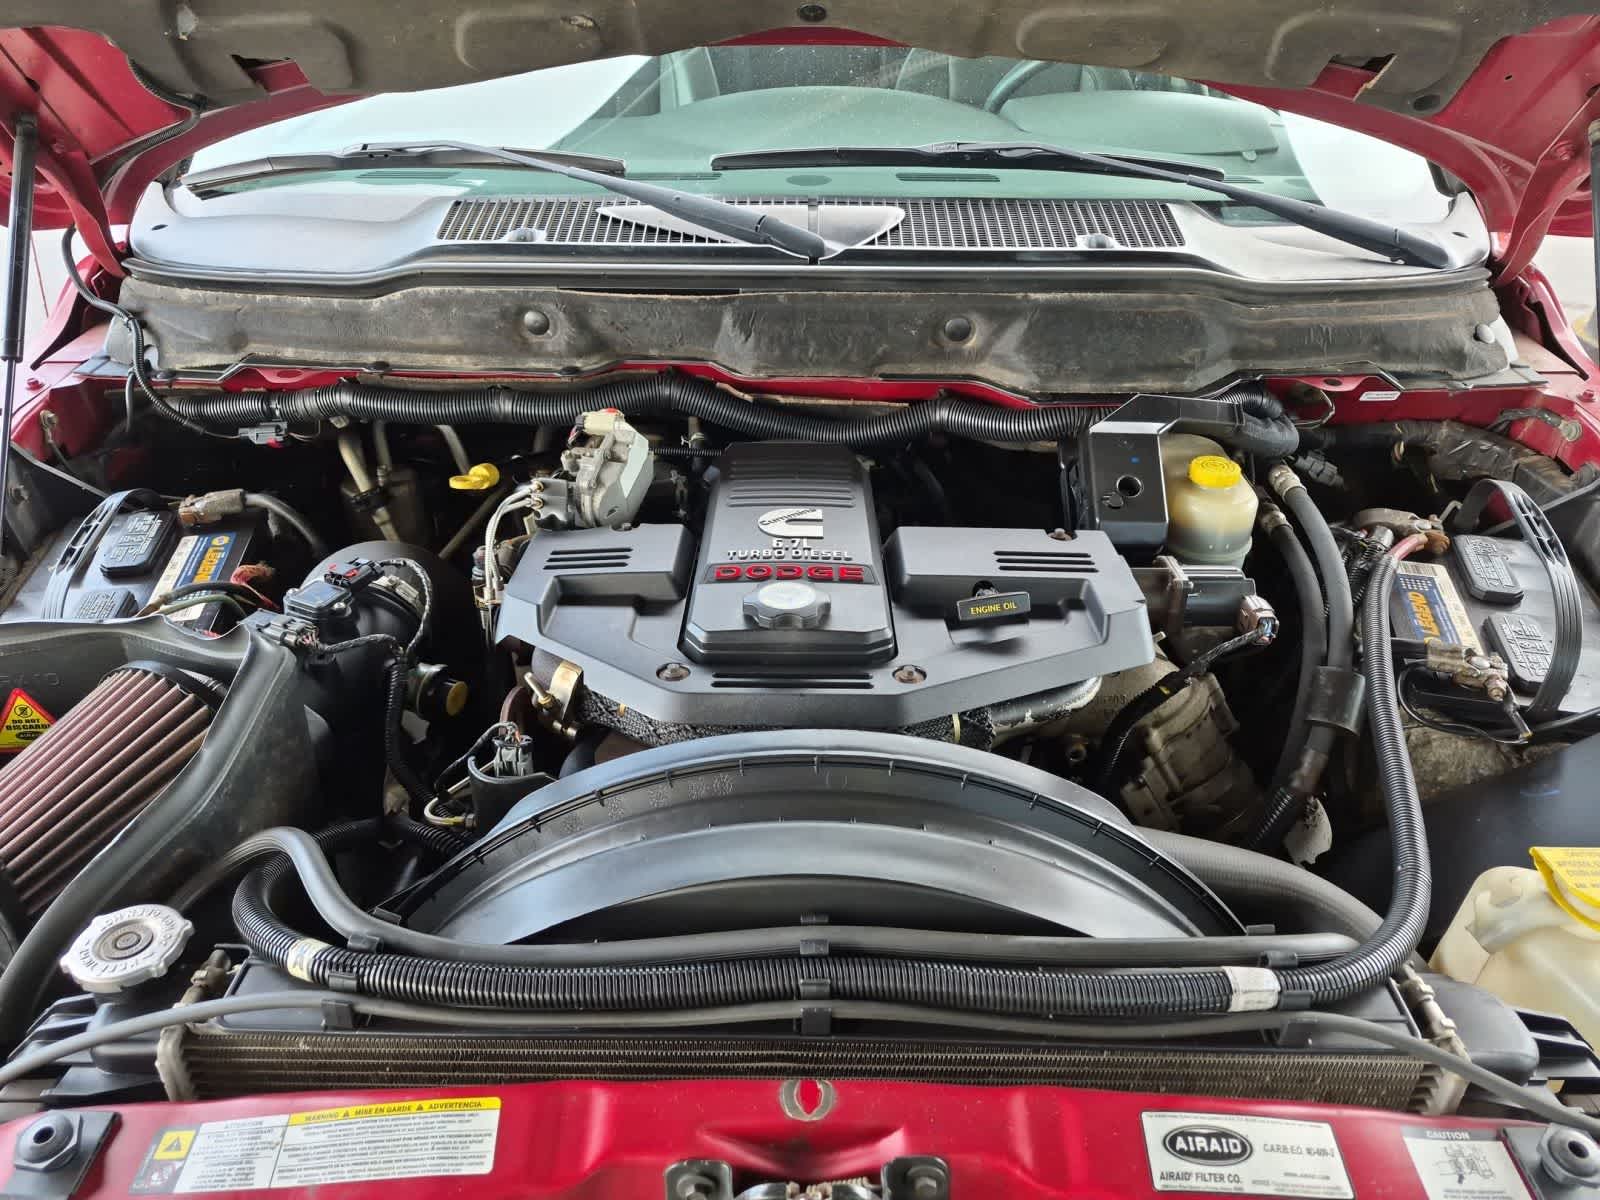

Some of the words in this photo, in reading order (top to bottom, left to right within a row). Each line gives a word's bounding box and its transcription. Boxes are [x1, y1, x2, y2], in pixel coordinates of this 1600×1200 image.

[759, 508, 817, 526] Cummins
[771, 537, 811, 551] 6.7L
[728, 548, 785, 560] TURBO
[791, 549, 853, 561] DIESEL
[714, 564, 865, 582] DODGE
[970, 604, 1001, 615] ENGINE
[1003, 601, 1017, 610] OIL
[304, 1111, 340, 1121] WARNING
[354, 1106, 373, 1116] MISE
[374, 1105, 385, 1114] EN
[386, 1104, 412, 1113] GARDE
[428, 1101, 482, 1110] ADVERTENCIA
[1425, 1130, 1471, 1140] CAUTION
[1175, 1135, 1242, 1154] AIRAID
[1195, 1172, 1226, 1183] FILTER
